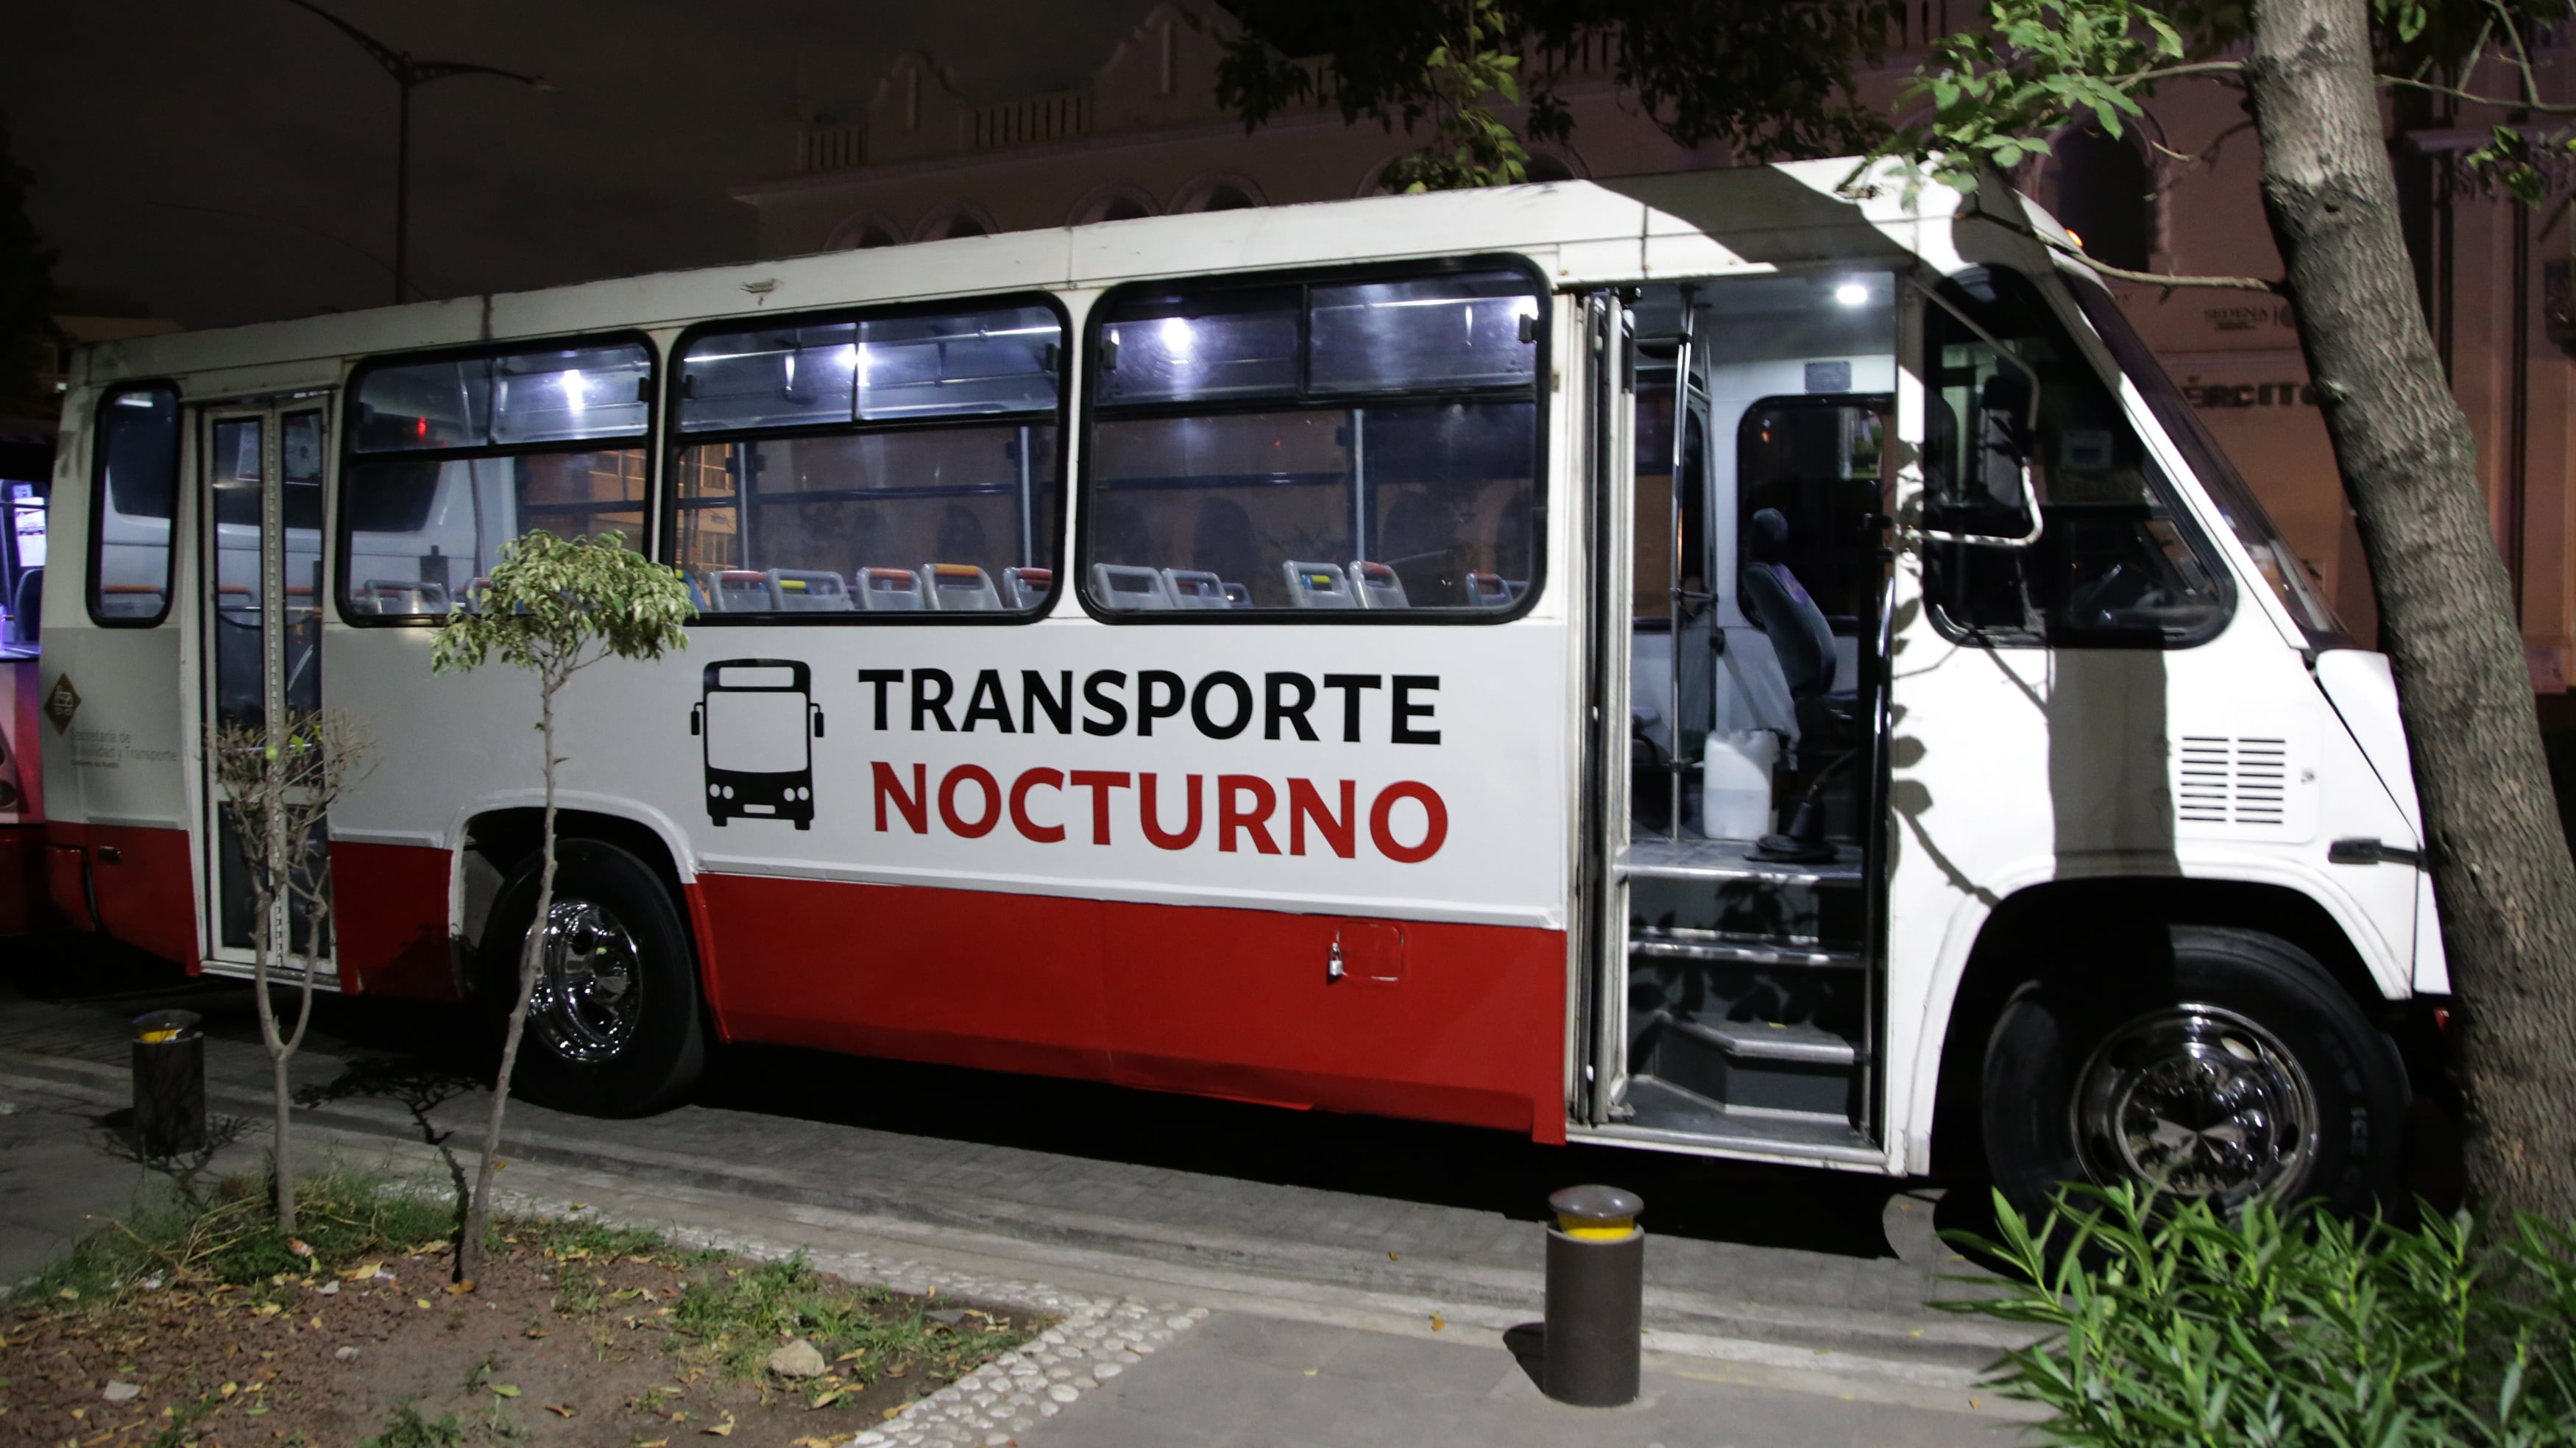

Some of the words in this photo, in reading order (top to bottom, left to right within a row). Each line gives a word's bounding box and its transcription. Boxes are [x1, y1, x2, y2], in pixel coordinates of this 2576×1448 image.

[858, 667, 1441, 745] TRANSPORTE
[125, 745, 177, 762] Transporte
[871, 761, 1448, 862] NOCTURNO
